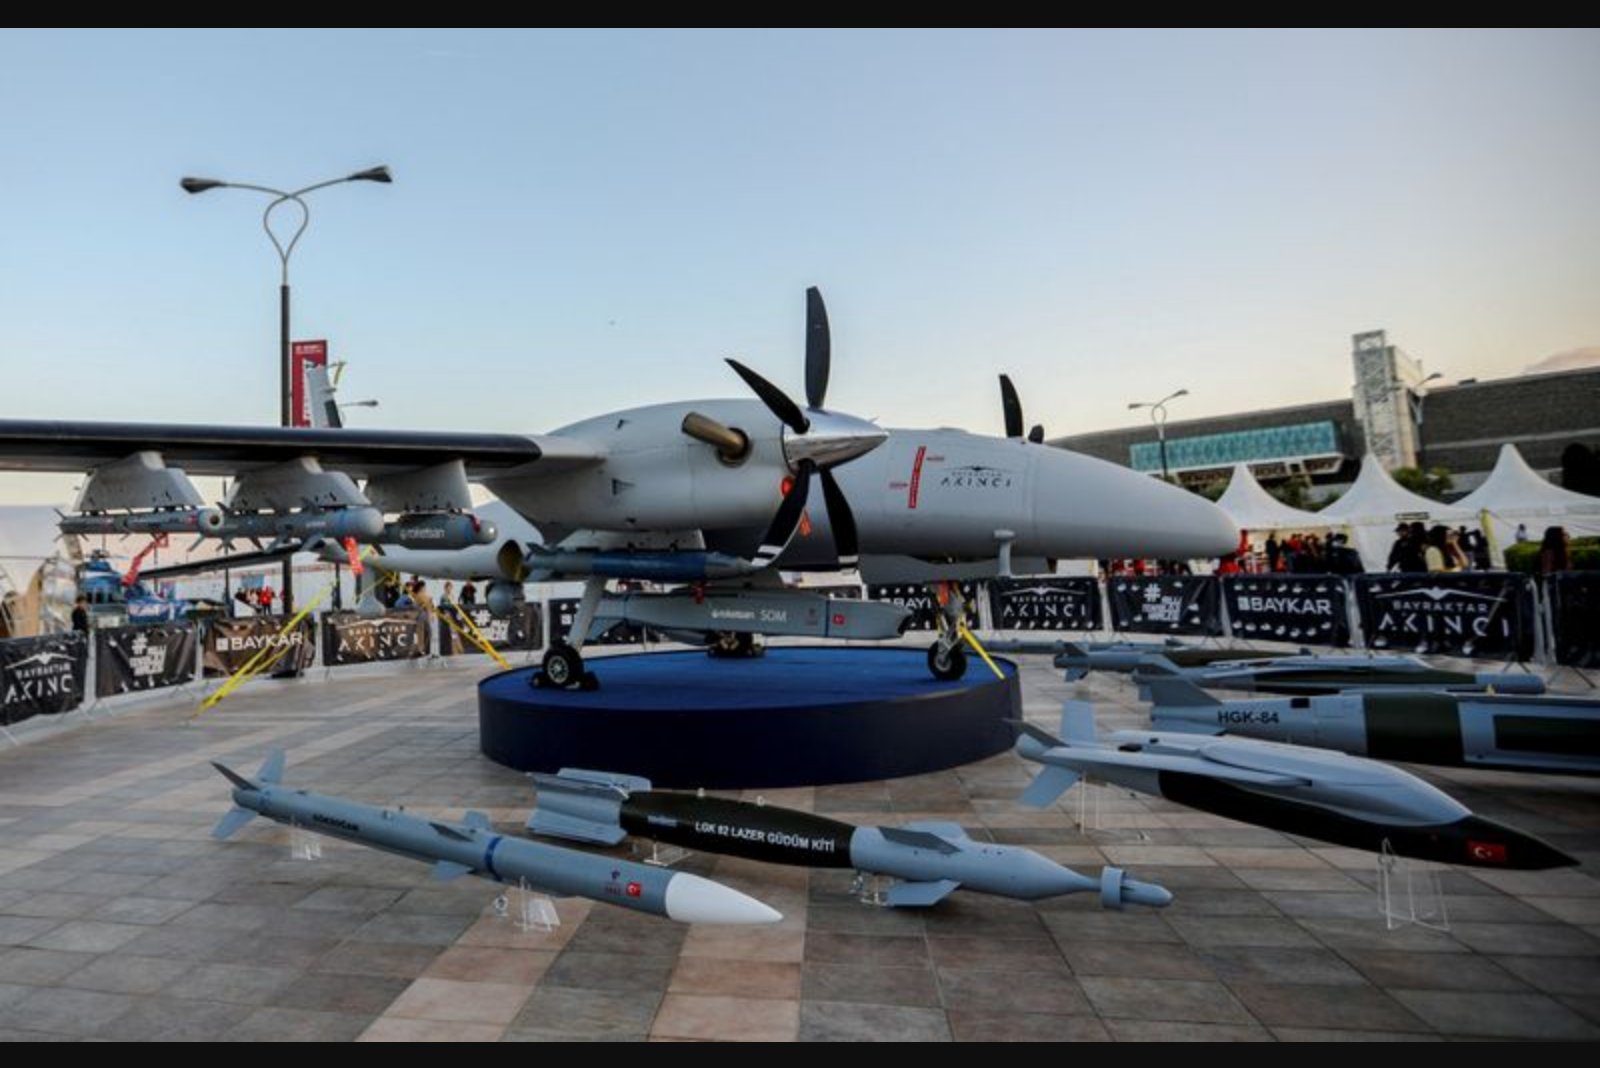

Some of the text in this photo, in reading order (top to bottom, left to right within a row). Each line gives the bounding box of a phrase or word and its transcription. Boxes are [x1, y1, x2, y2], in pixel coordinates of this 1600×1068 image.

[1003, 603, 1086, 617] AKINCI
[1251, 597, 1333, 615] BAYKAR
[1393, 602, 1488, 612] BAYRAKTAR
[1378, 612, 1509, 637] AKINCI
[231, 632, 303, 651] BAYKAR
[1217, 710, 1279, 724] HGK-84
[731, 827, 765, 842] LAZER
